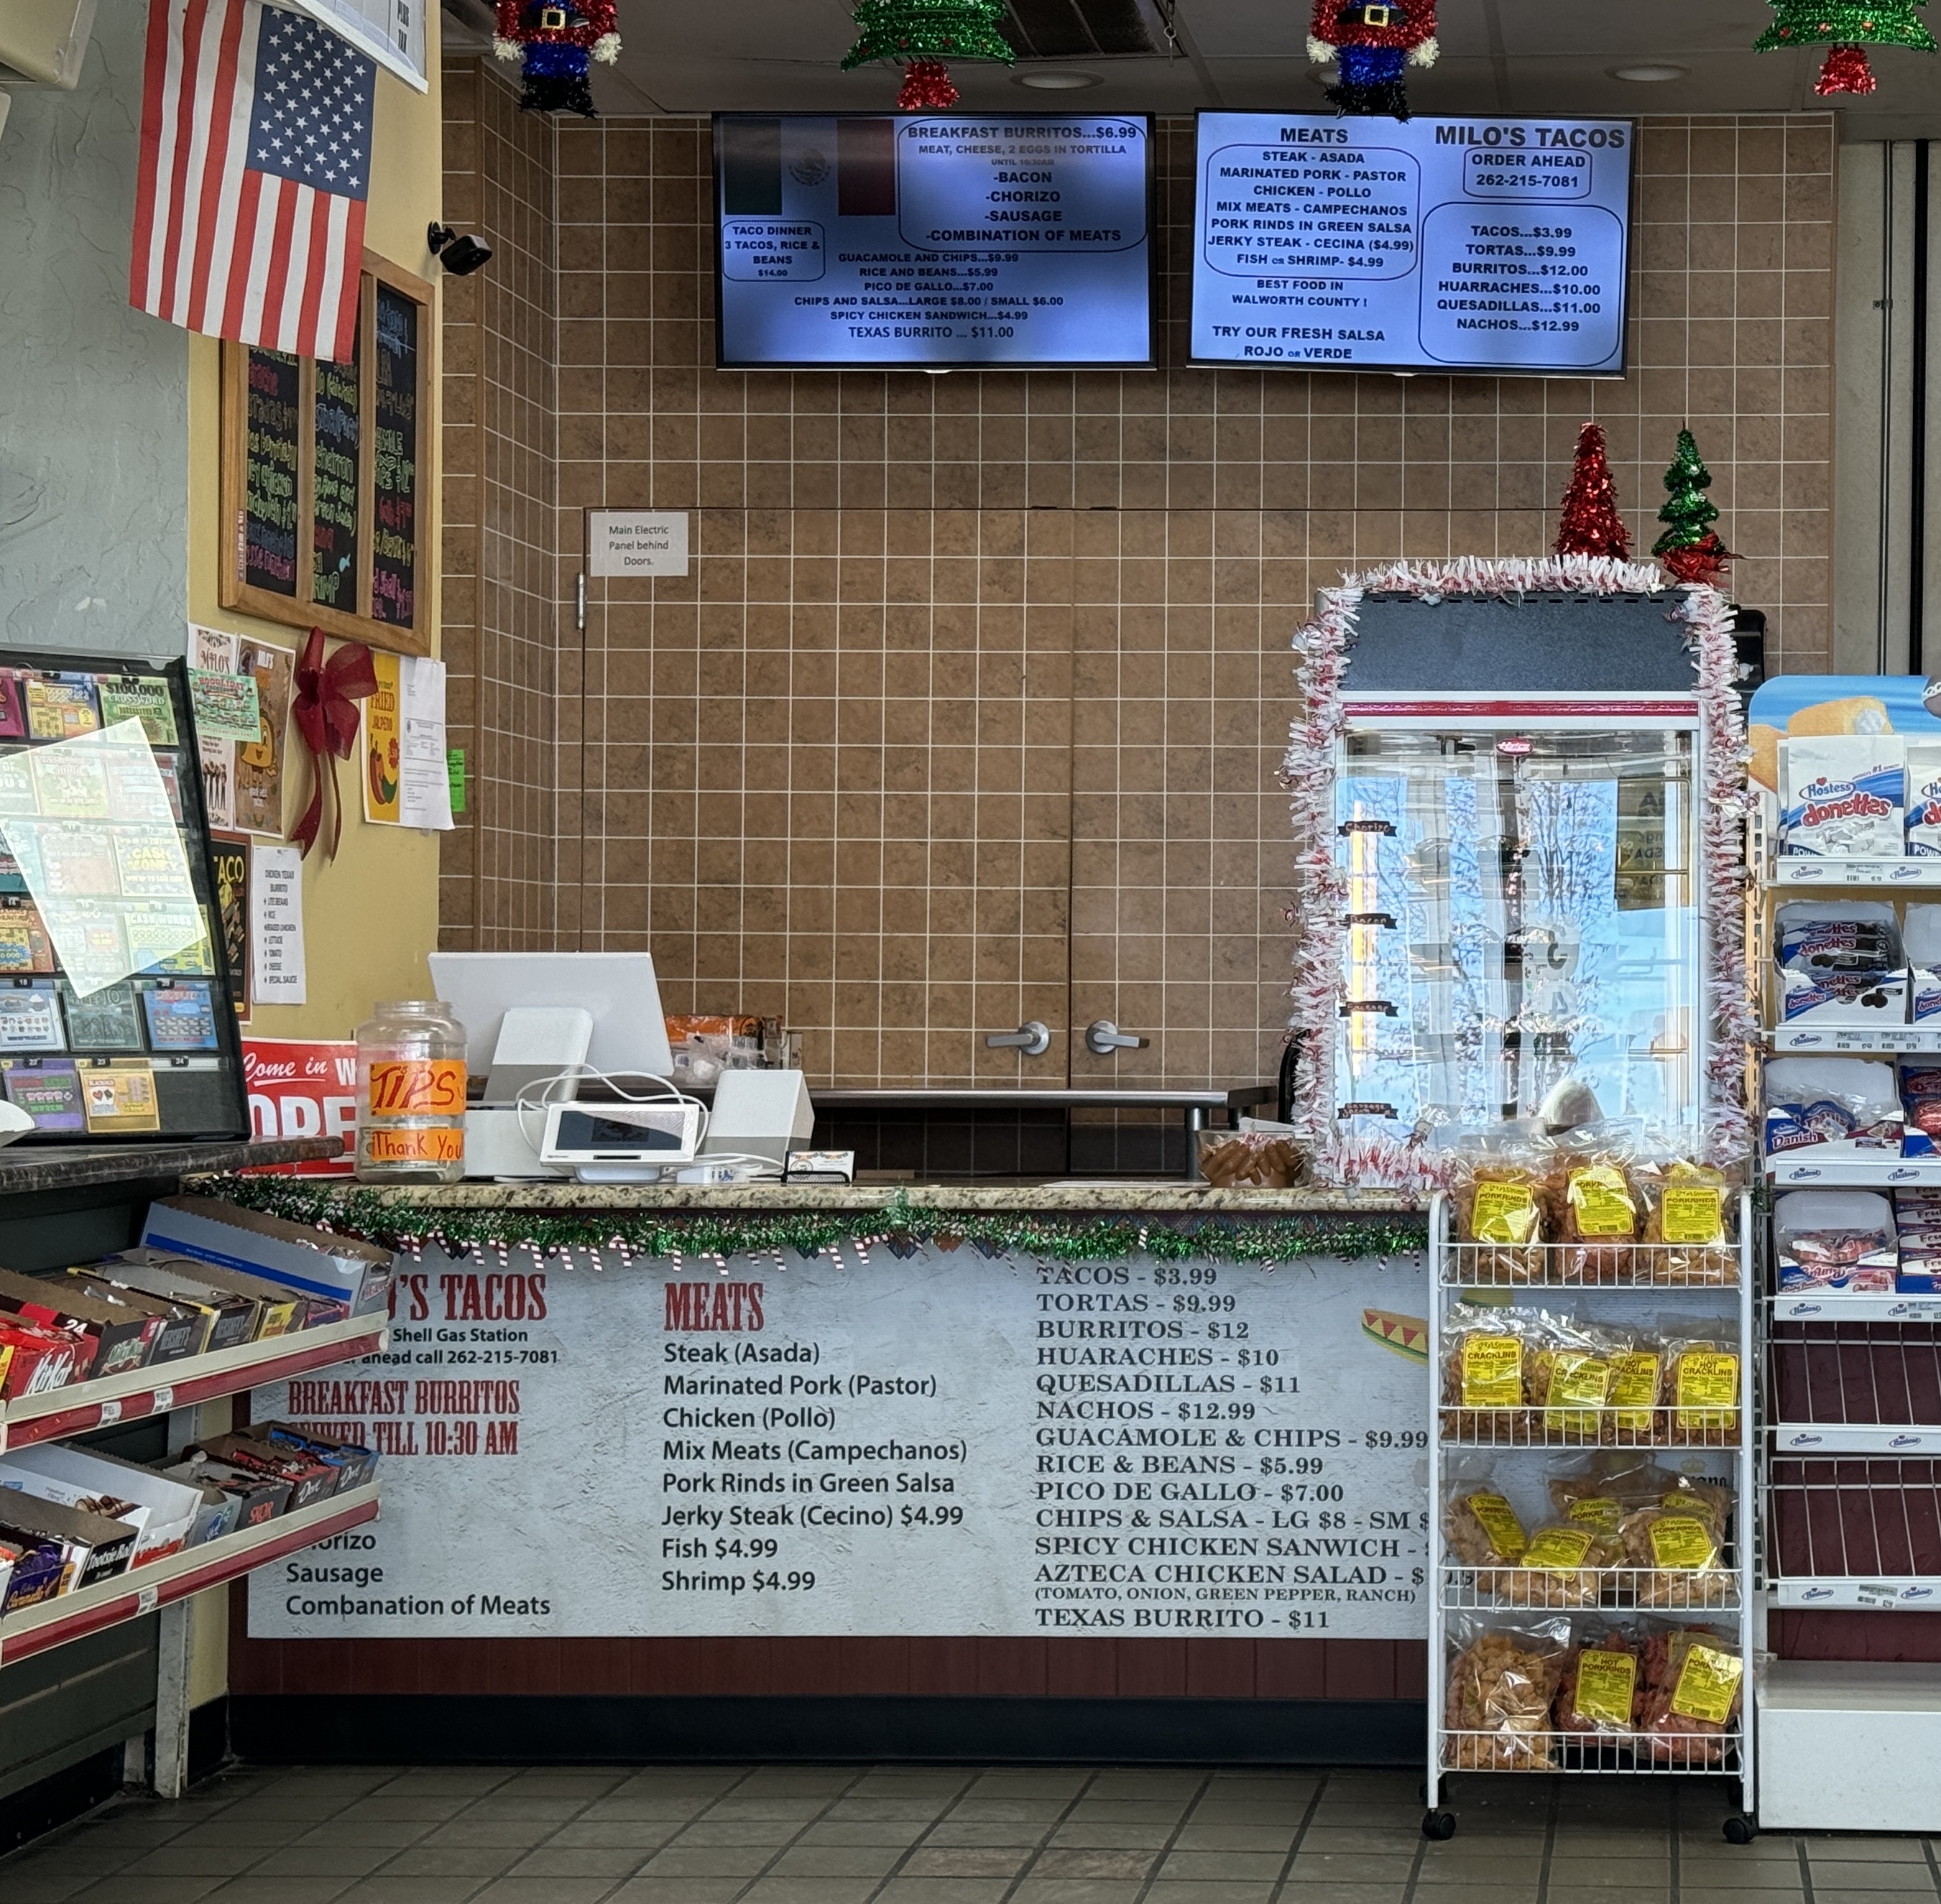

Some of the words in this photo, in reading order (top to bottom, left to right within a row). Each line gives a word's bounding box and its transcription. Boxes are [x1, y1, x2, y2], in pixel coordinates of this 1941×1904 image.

[908, 127, 999, 139] BREAKFAST
[1281, 128, 1348, 144] MEATS
[1436, 126, 1526, 147] MILO'S
[1534, 127, 1626, 149] TACOS
[918, 144, 953, 156] MEAT,
[956, 144, 1006, 156] CHEESE,
[1008, 144, 1015, 154] 2
[1018, 144, 1051, 154] EGGS
[1054, 145, 1066, 154] IN
[1068, 144, 1127, 157] TORTILLA
[1263, 151, 1308, 162] STEAK
[1319, 152, 1365, 164] ASADA
[1472, 154, 1526, 167] ORDER
[1531, 154, 1586, 167] AHEAD
[994, 171, 1053, 184] -BACON
[1220, 167, 1299, 179] MARINATED
[1303, 169, 1341, 180] PORK
[1352, 170, 1406, 182] PASTOR
[1476, 173, 1578, 188] 262-215-7081
[986, 190, 1061, 203] -CHORIZO
[1253, 185, 1315, 197] CHICKEN
[1327, 187, 1372, 198] POLLO
[1217, 201, 1242, 212] MIX
[1245, 202, 1291, 213] MEATS
[1303, 203, 1408, 216] CAMPECHANOS
[985, 210, 1064, 223] -SAUSAGE
[732, 226, 764, 236] TACO
[767, 226, 813, 236] DINNER
[1211, 218, 1249, 229] PORK
[1253, 219, 1295, 231] RINDS
[1299, 221, 1313, 231] IN
[1317, 221, 1364, 232] GREEN
[1368, 222, 1412, 234] SALSA
[926, 229, 1040, 241] -COMBINATION
[1044, 230, 1065, 241] OF
[1069, 229, 1122, 241] MEATS
[724, 241, 732, 250] 3
[734, 241, 777, 251] TACOS,
[780, 241, 808, 250] RICE
[811, 241, 820, 250] &
[1207, 235, 1253, 246] JERKY
[1257, 236, 1302, 248] STEAK
[1314, 238, 1365, 249] CECINA
[1368, 239, 1414, 253] ($4.99)
[753, 255, 793, 265] BEANS
[838, 253, 911, 262] GUACAMOLE
[914, 253, 939, 262] AND
[1257, 279, 1289, 289] BEST
[1293, 280, 1327, 290] FOOD
[1330, 282, 1343, 291] IN
[1232, 295, 1304, 306] WALWORTH
[1307, 297, 1360, 308] COUNTY
[830, 310, 865, 320] SPICY
[868, 311, 921, 320] CHICKEN
[848, 326, 890, 338] TEXAS
[894, 325, 954, 338] BURRITO
[970, 325, 1014, 339] $11.00
[1212, 325, 1241, 337] TRY
[1245, 327, 1277, 338] OUR
[1281, 327, 1332, 340] FRESH
[1337, 329, 1385, 341] SALSA
[609, 525, 632, 535] Main
[635, 525, 669, 535] Electric
[609, 540, 635, 550] Panel
[637, 540, 669, 550] behind
[624, 556, 654, 566] Doors.
[1806, 782, 1852, 798] Hostess
[1802, 792, 1891, 828] donettes
[213, 855, 244, 884] ACO
[243, 1052, 297, 1083] Come
[305, 1056, 328, 1075] in
[374, 1131, 427, 1158] Thank
[438, 1134, 462, 1160] You
[1772, 1130, 1819, 1150] Danish
[1036, 1266, 1130, 1285] TACOS
[1153, 1267, 1217, 1287] $3.99
[439, 1272, 547, 1321] TACOS
[664, 1282, 764, 1331] MEATS
[65, 1318, 88, 1335] 24
[392, 1327, 432, 1342] Shell
[436, 1328, 466, 1342] Gas
[470, 1328, 528, 1342] Station
[416, 1350, 443, 1364] call
[447, 1350, 558, 1364] 262-215-7081
[1037, 1347, 1213, 1366] HUARACHES
[1237, 1349, 1279, 1368] $10
[1467, 1351, 1517, 1360] CRACKLINS
[1683, 1367, 1733, 1377] CRACKLINS
[1036, 1374, 1235, 1396] QUESADILLAS
[1260, 1375, 1299, 1395] $11
[287, 1380, 409, 1415] BREAKFAST
[414, 1380, 520, 1415] BURRITOS
[376, 1421, 419, 1456] TILL
[425, 1420, 479, 1456] 10:30
[484, 1420, 518, 1455] AM
[661, 1505, 724, 1531] Jerky
[729, 1504, 794, 1525] Steak
[800, 1505, 893, 1528] (Cecino)
[900, 1504, 964, 1528] $4.99
[312, 1531, 376, 1550] orizo
[1035, 1536, 1120, 1556] SPICY
[1128, 1537, 1259, 1556] CHICKEN
[1266, 1538, 1400, 1558] SANWICH
[286, 1562, 384, 1588] Sausage
[662, 1570, 746, 1596] Shrimp
[752, 1569, 816, 1593] $4.99
[1035, 1587, 1122, 1601] (TOMATO,
[1126, 1587, 1191, 1602] ONION,
[1195, 1588, 1258, 1600] GREEN
[1264, 1588, 1342, 1603] PEPPER,
[1347, 1589, 1416, 1604] RANCH)
[285, 1594, 443, 1616] Combanation
[451, 1594, 476, 1615] of
[481, 1595, 550, 1615] Meats
[1035, 1608, 1125, 1627] TEXAS
[1134, 1609, 1264, 1628] BURRITO
[1288, 1610, 1329, 1630] $11
[1582, 1663, 1631, 1675] PORKRINDS
